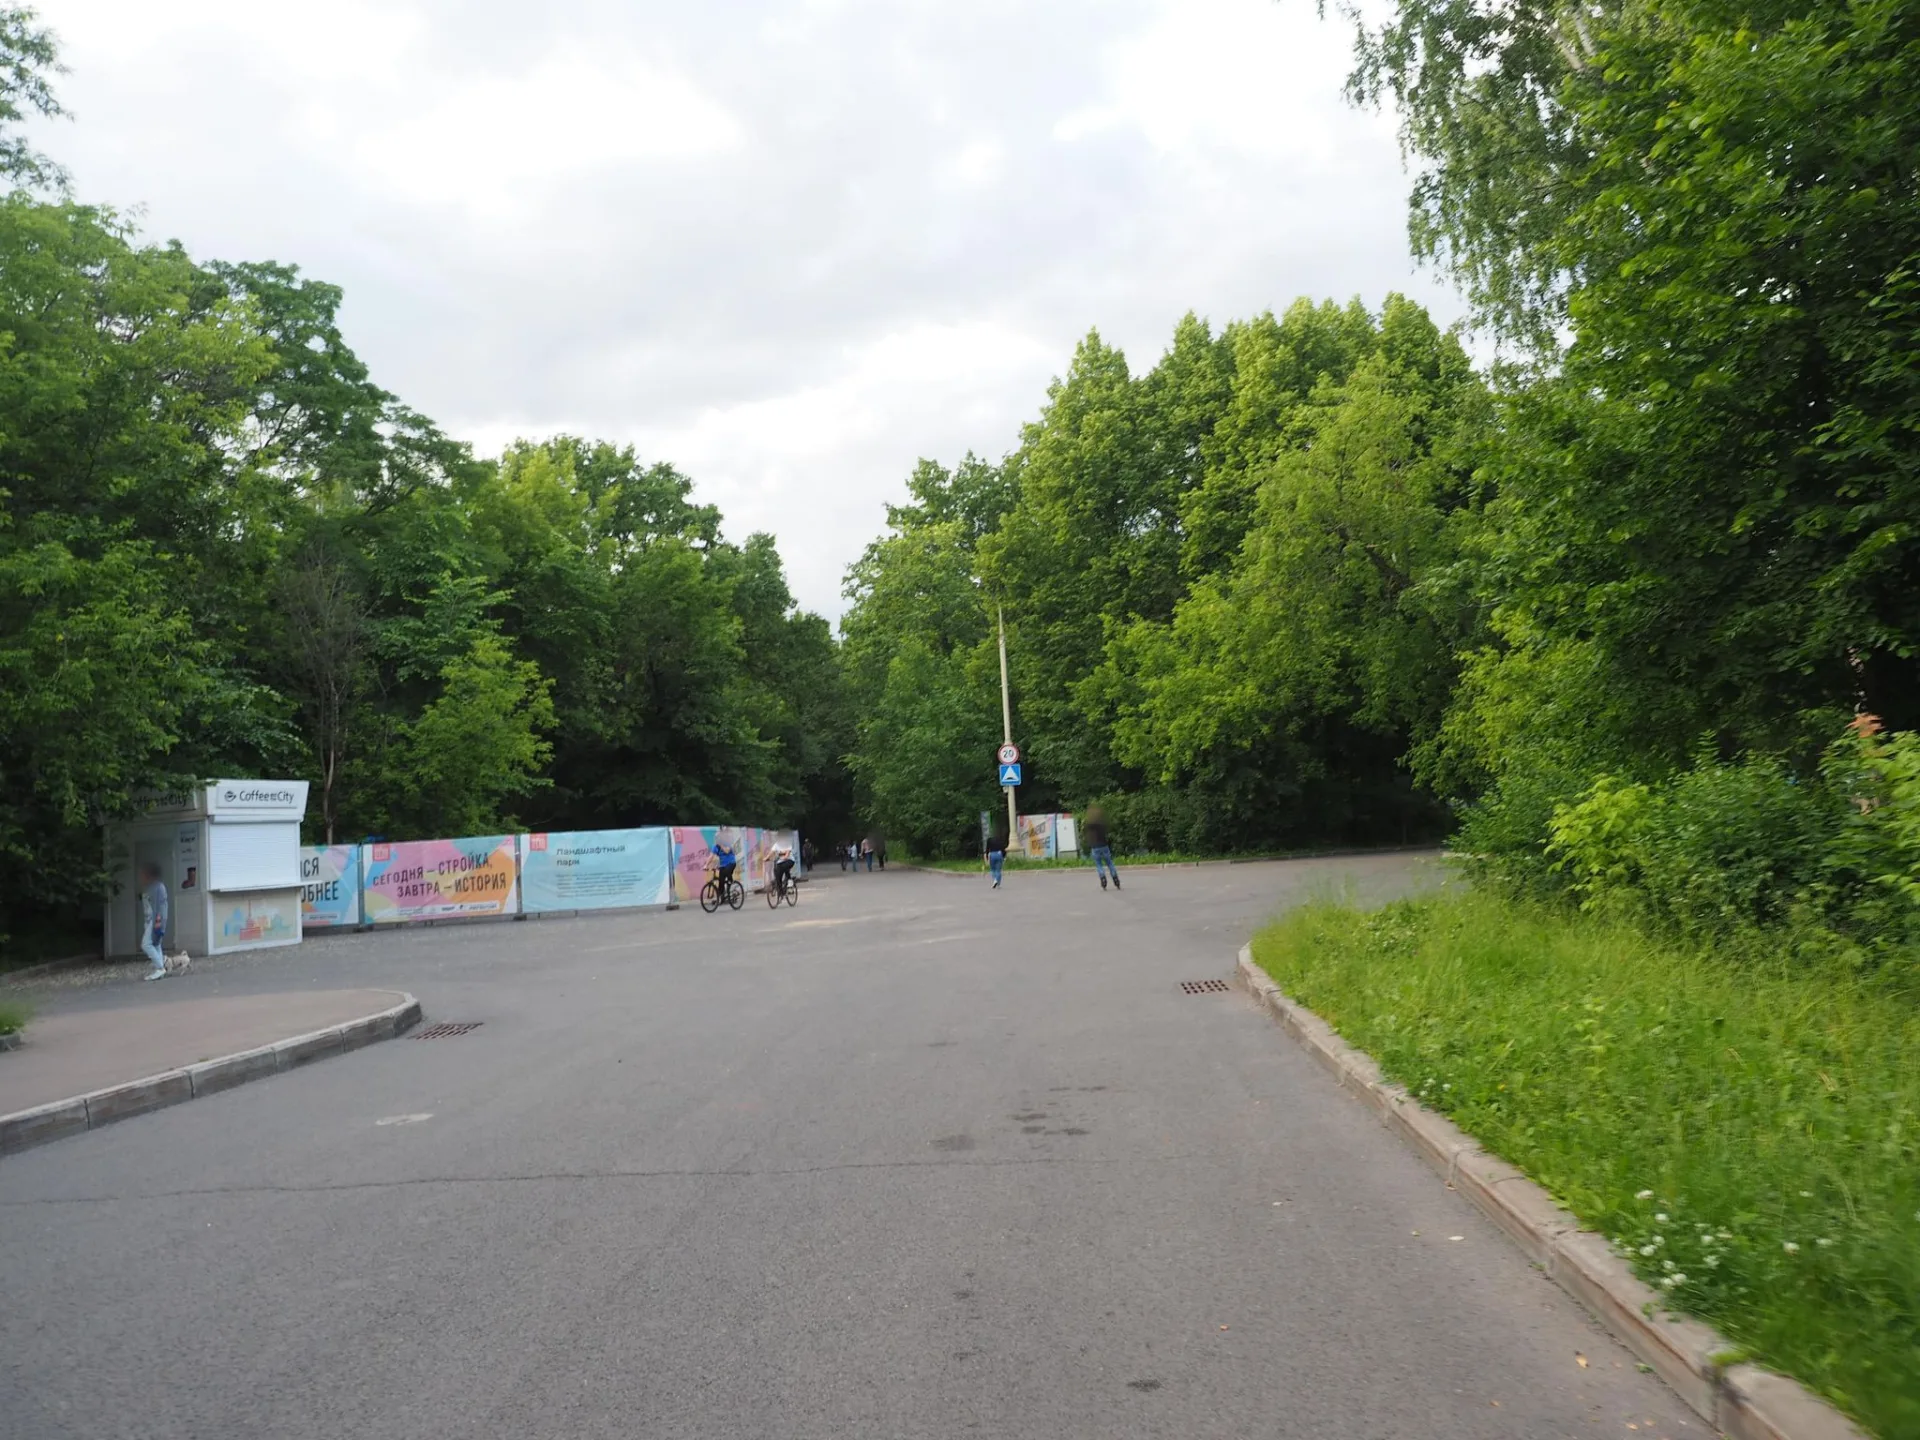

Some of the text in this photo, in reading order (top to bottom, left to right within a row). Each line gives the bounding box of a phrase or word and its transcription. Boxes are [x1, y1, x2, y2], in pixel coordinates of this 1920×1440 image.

[1003, 750, 1014, 758] 20
[373, 866, 423, 886] СЕГОДНЯ
[438, 851, 493, 876] СТРОЙКА,
[397, 881, 440, 898] ЗАВТРА
[455, 872, 506, 893] ИСТОРИЯ
